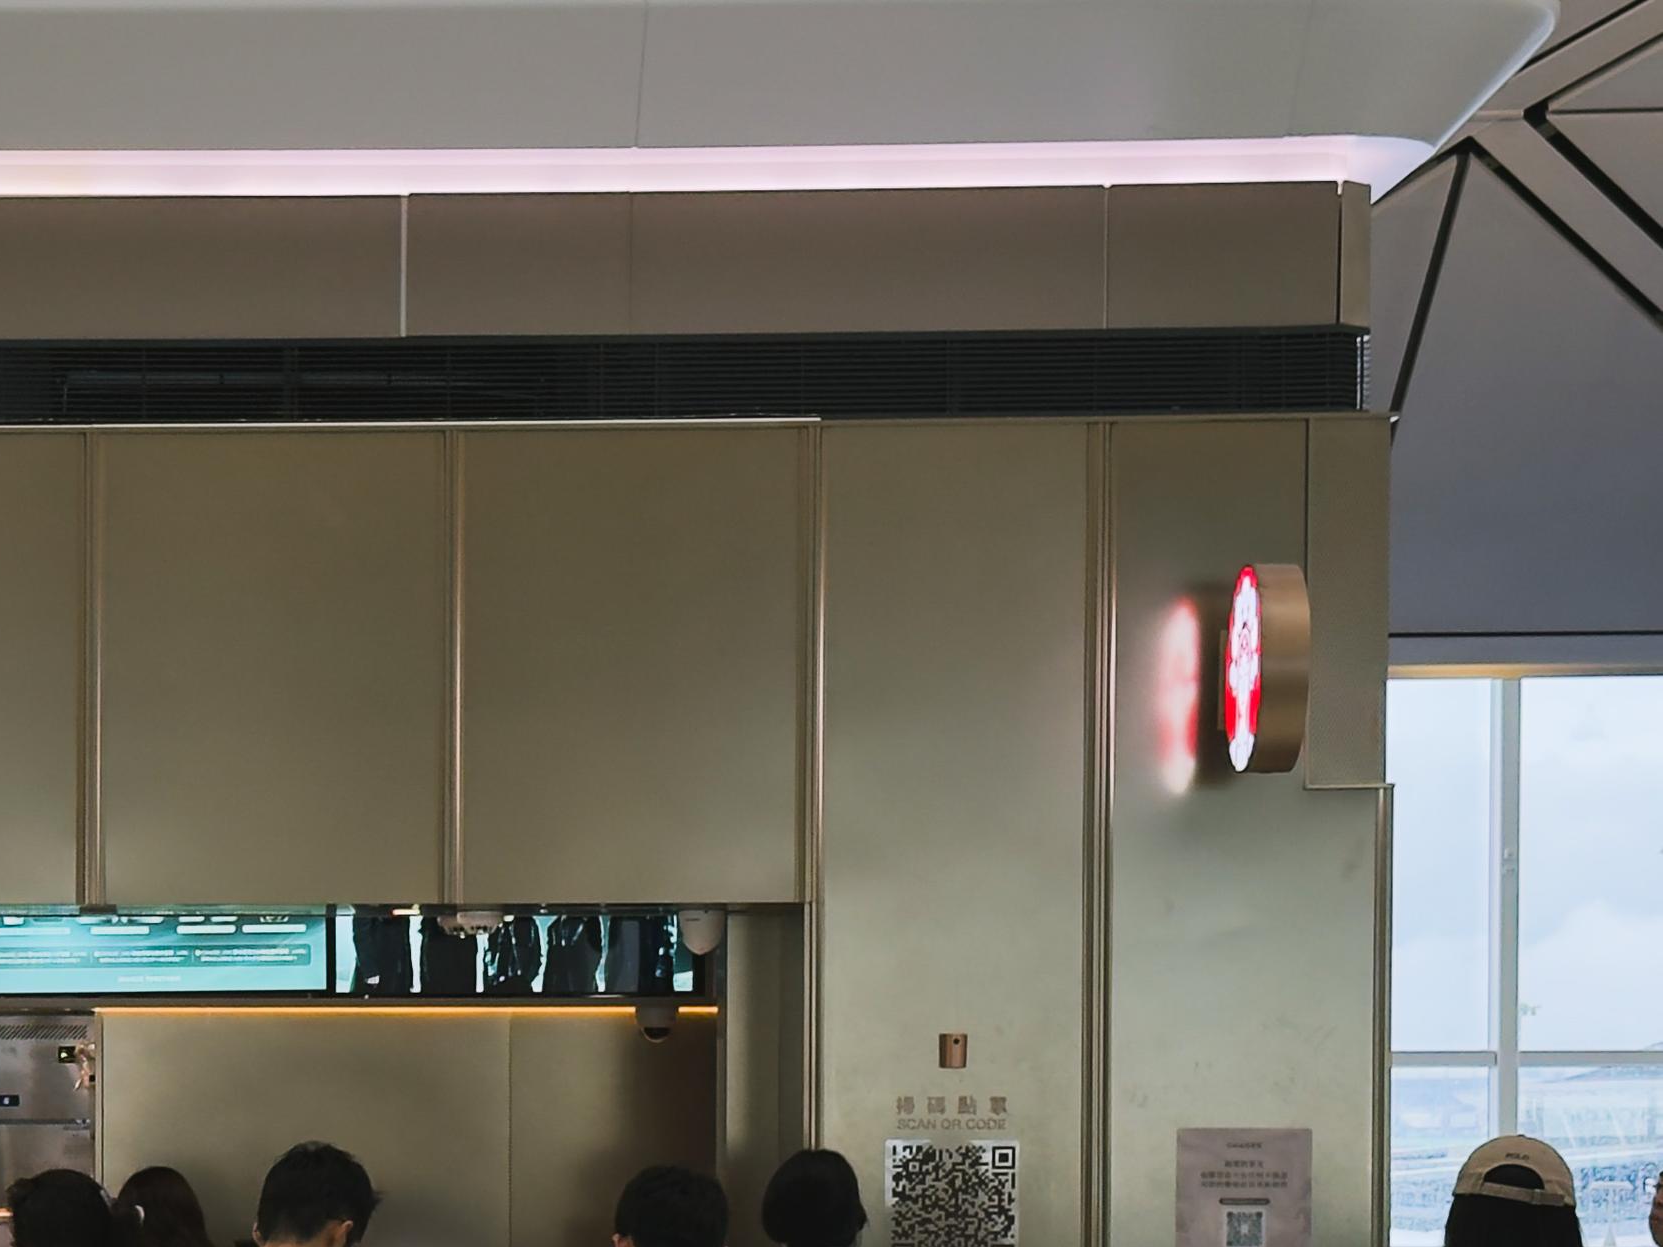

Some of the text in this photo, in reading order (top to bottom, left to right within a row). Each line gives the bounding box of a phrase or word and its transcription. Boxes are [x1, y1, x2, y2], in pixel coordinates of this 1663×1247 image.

[897, 1118, 1008, 1130] SCAN QR CODE
